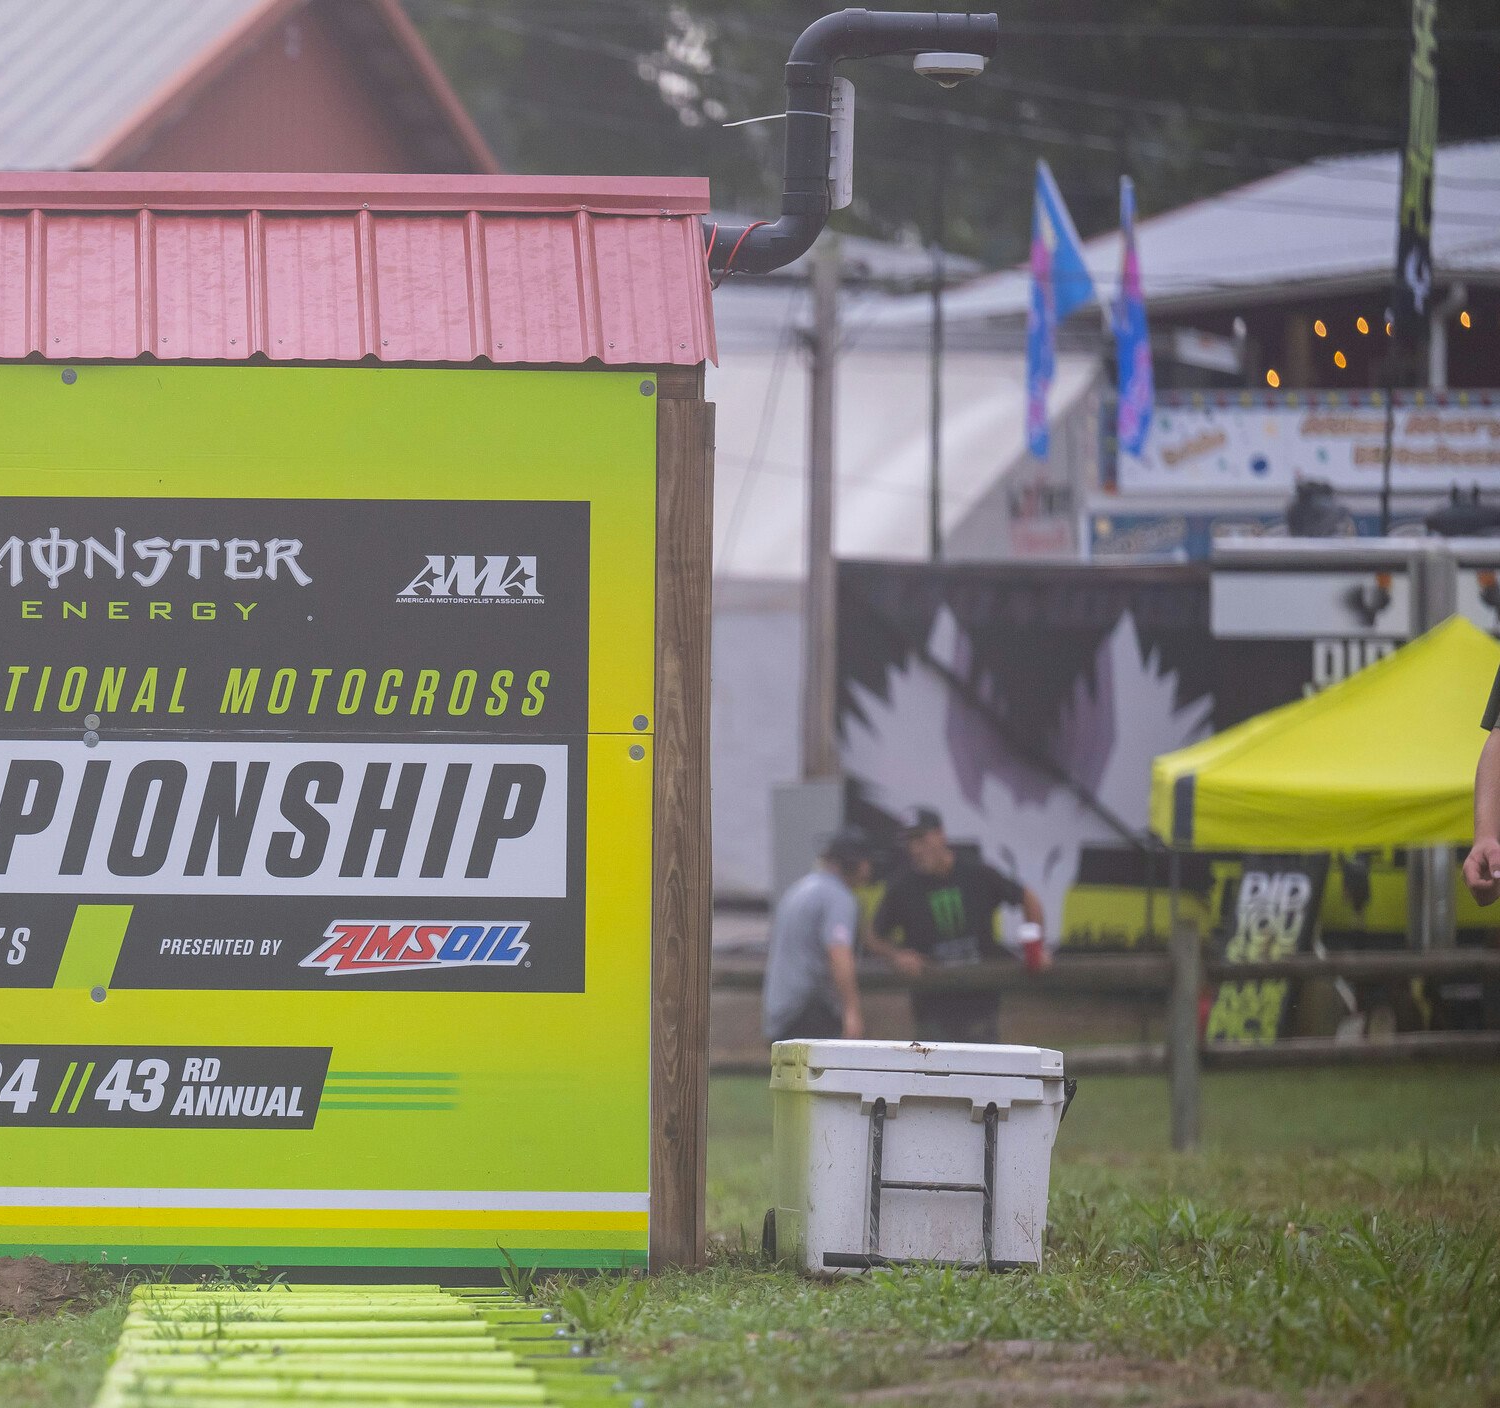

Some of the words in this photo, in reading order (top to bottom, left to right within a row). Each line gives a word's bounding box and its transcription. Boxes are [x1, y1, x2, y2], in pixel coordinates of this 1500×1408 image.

[396, 555, 545, 597] AMA
[20, 600, 258, 621] ENERGY
[436, 597, 494, 605] MOTORCYCLIST
[219, 667, 551, 717] MOTOCROSS
[159, 938, 255, 957] PRESENTED
[259, 939, 283, 957] BY
[312, 924, 528, 966] AMSOIL
[94, 1058, 171, 1112] 43
[181, 1057, 221, 1082] RD
[170, 1086, 305, 1117] ANNUAL
